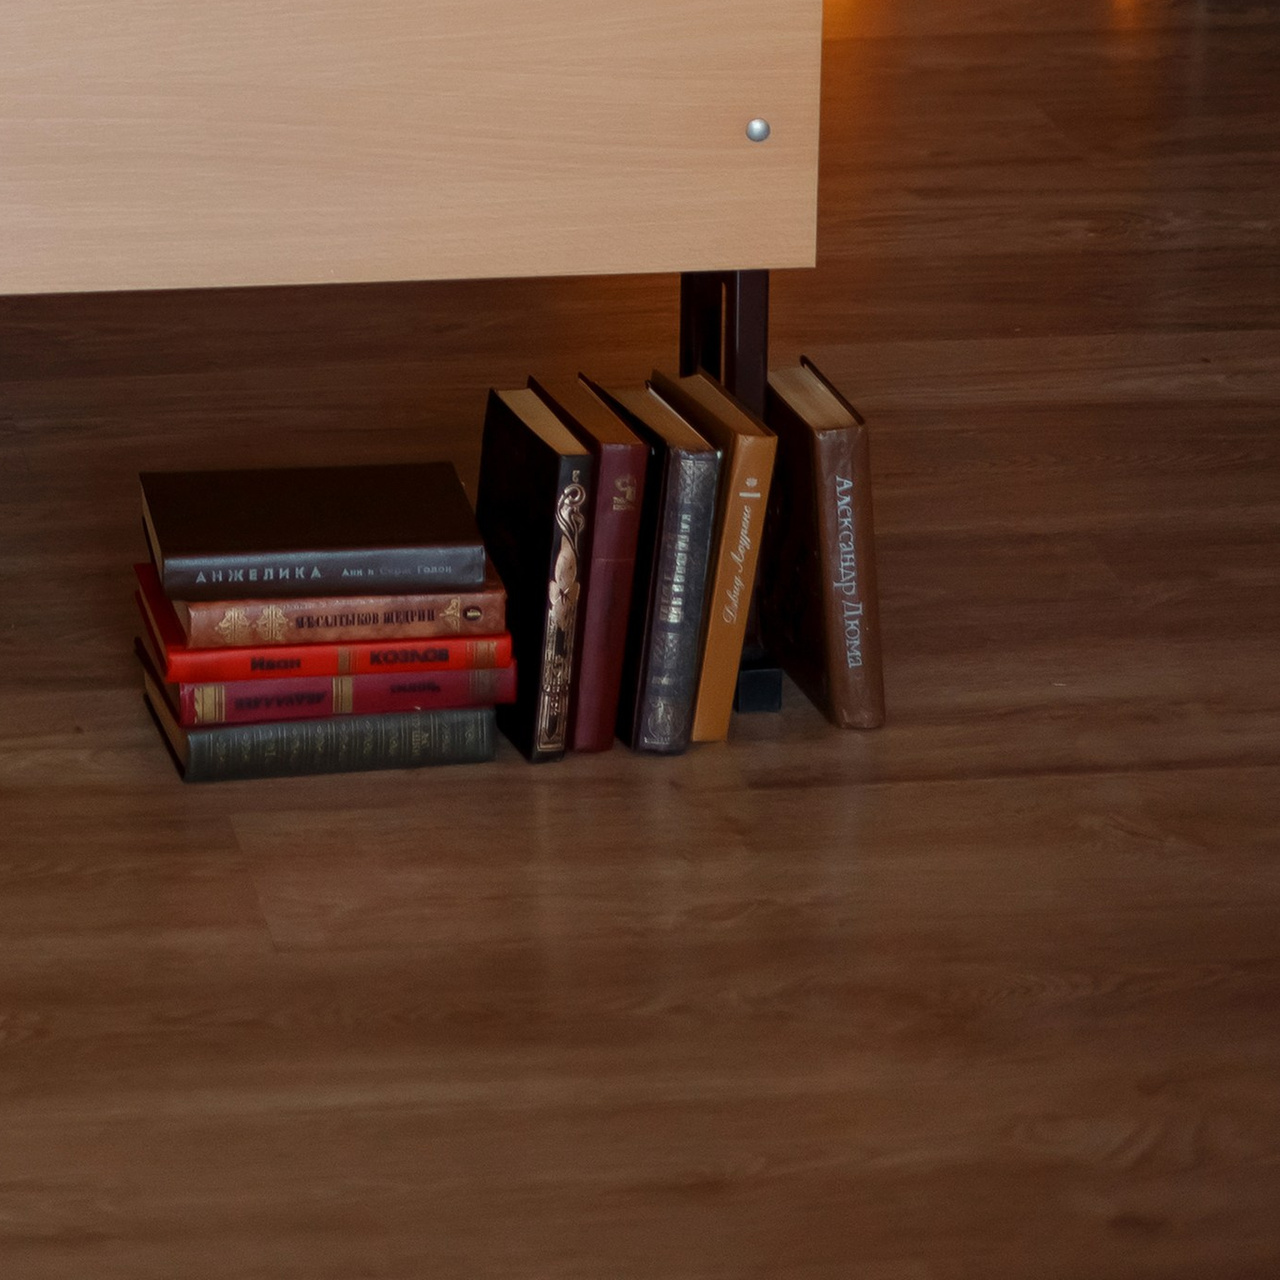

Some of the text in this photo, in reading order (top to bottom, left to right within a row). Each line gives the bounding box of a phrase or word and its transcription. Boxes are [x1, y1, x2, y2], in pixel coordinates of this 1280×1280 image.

[194, 565, 322, 584] АНЖЕЛИКА
[833, 475, 862, 670] Александр Дюма
